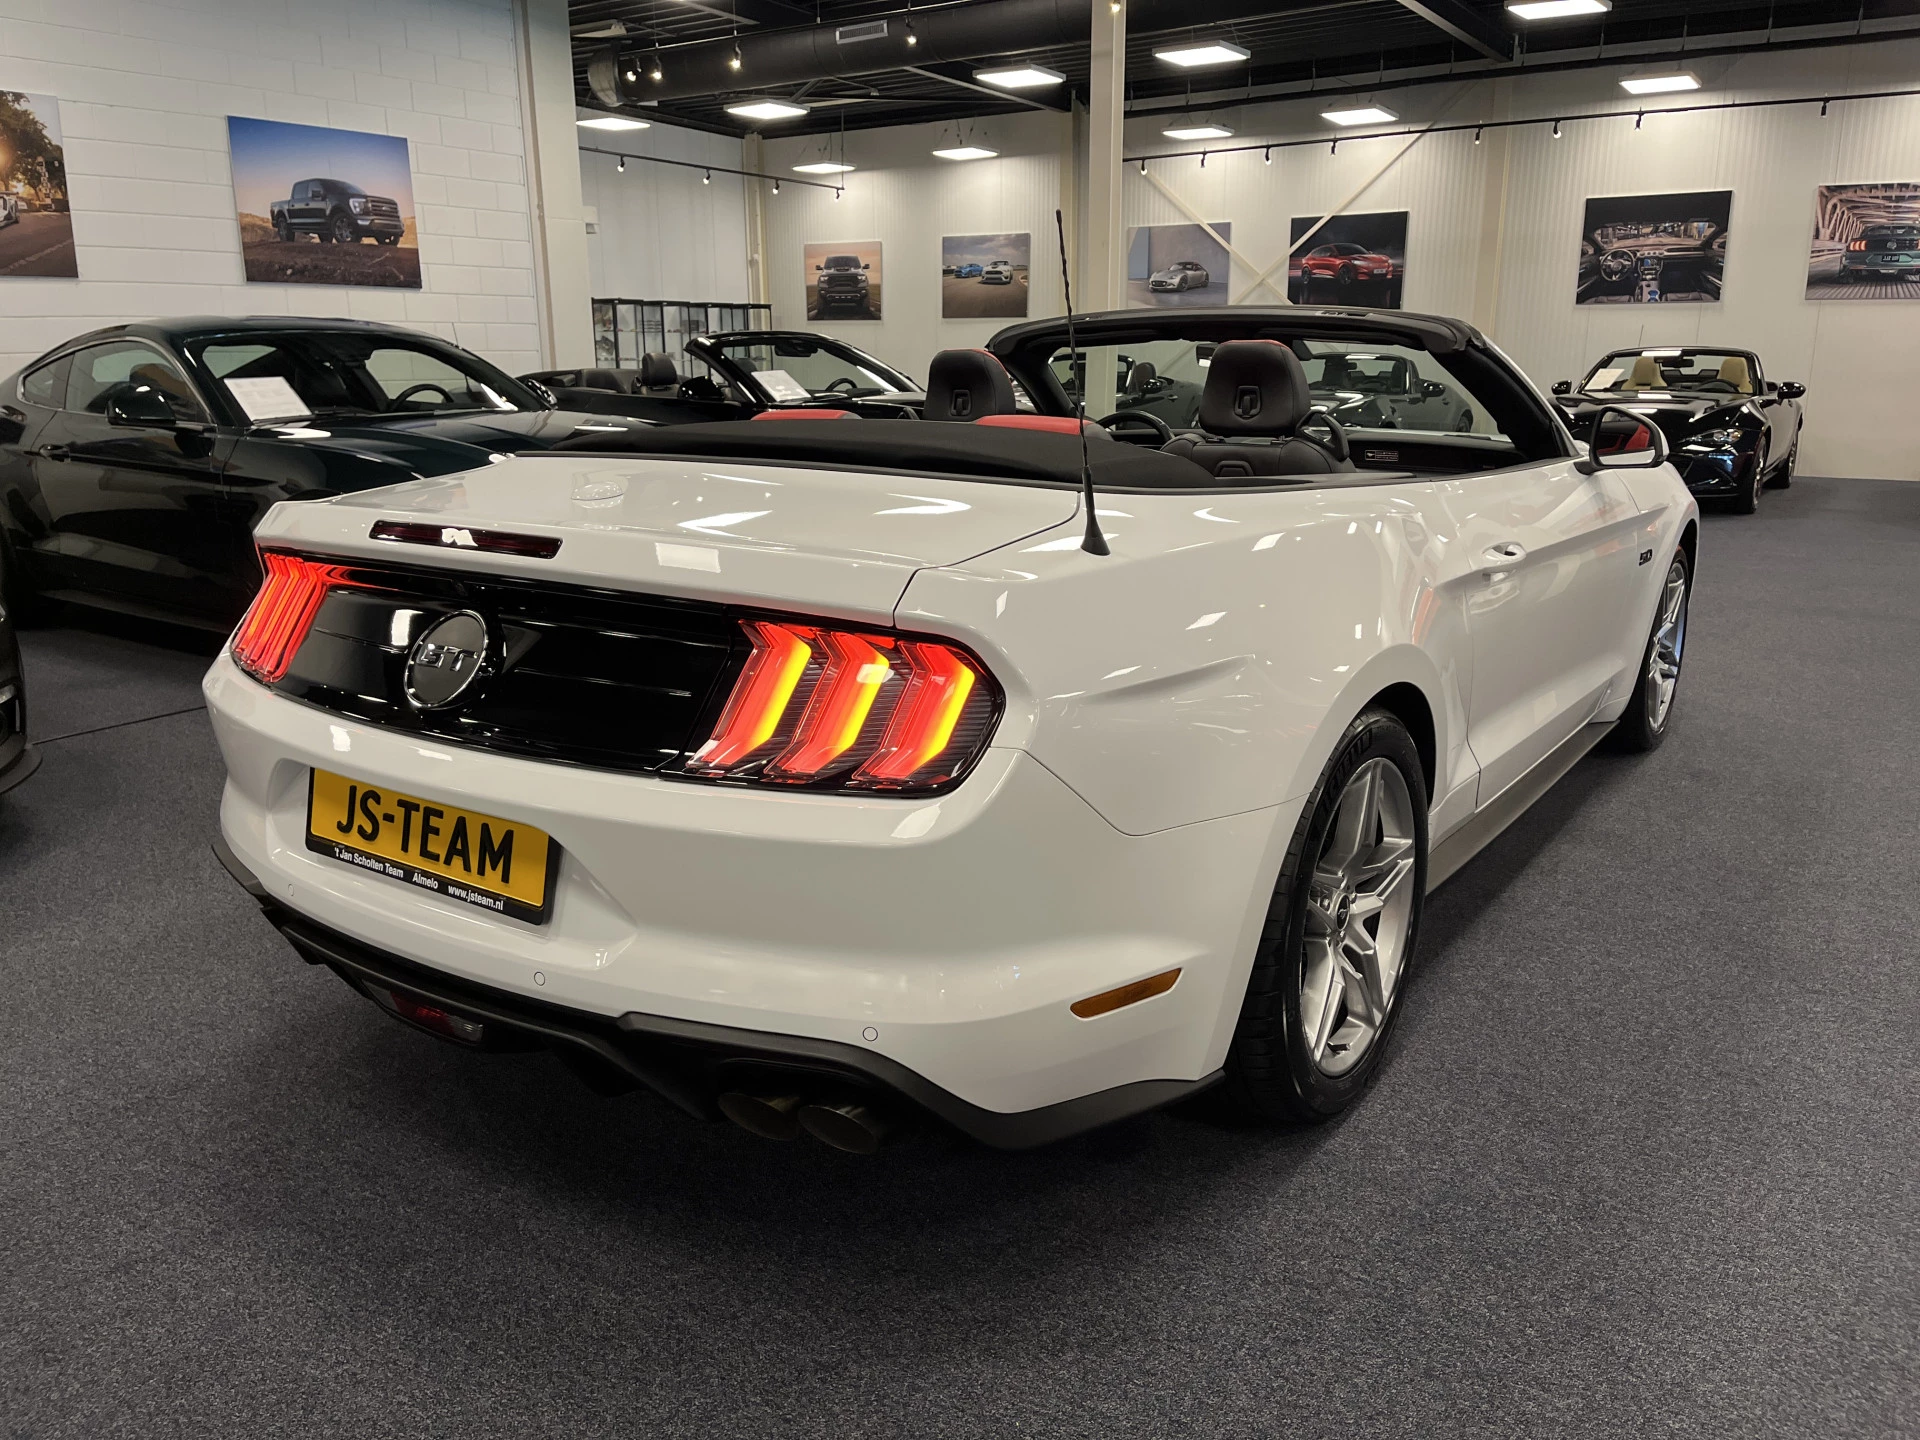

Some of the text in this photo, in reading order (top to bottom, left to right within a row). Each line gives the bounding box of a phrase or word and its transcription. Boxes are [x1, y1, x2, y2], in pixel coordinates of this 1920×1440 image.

[416, 643, 478, 672] GT
[336, 785, 515, 884] JS-TEAM
[339, 849, 352, 862] Jan
[353, 853, 384, 872] Scholten
[384, 863, 403, 878] Team
[412, 872, 439, 889] Almelo
[447, 884, 504, 911] www.jsteam.nl
